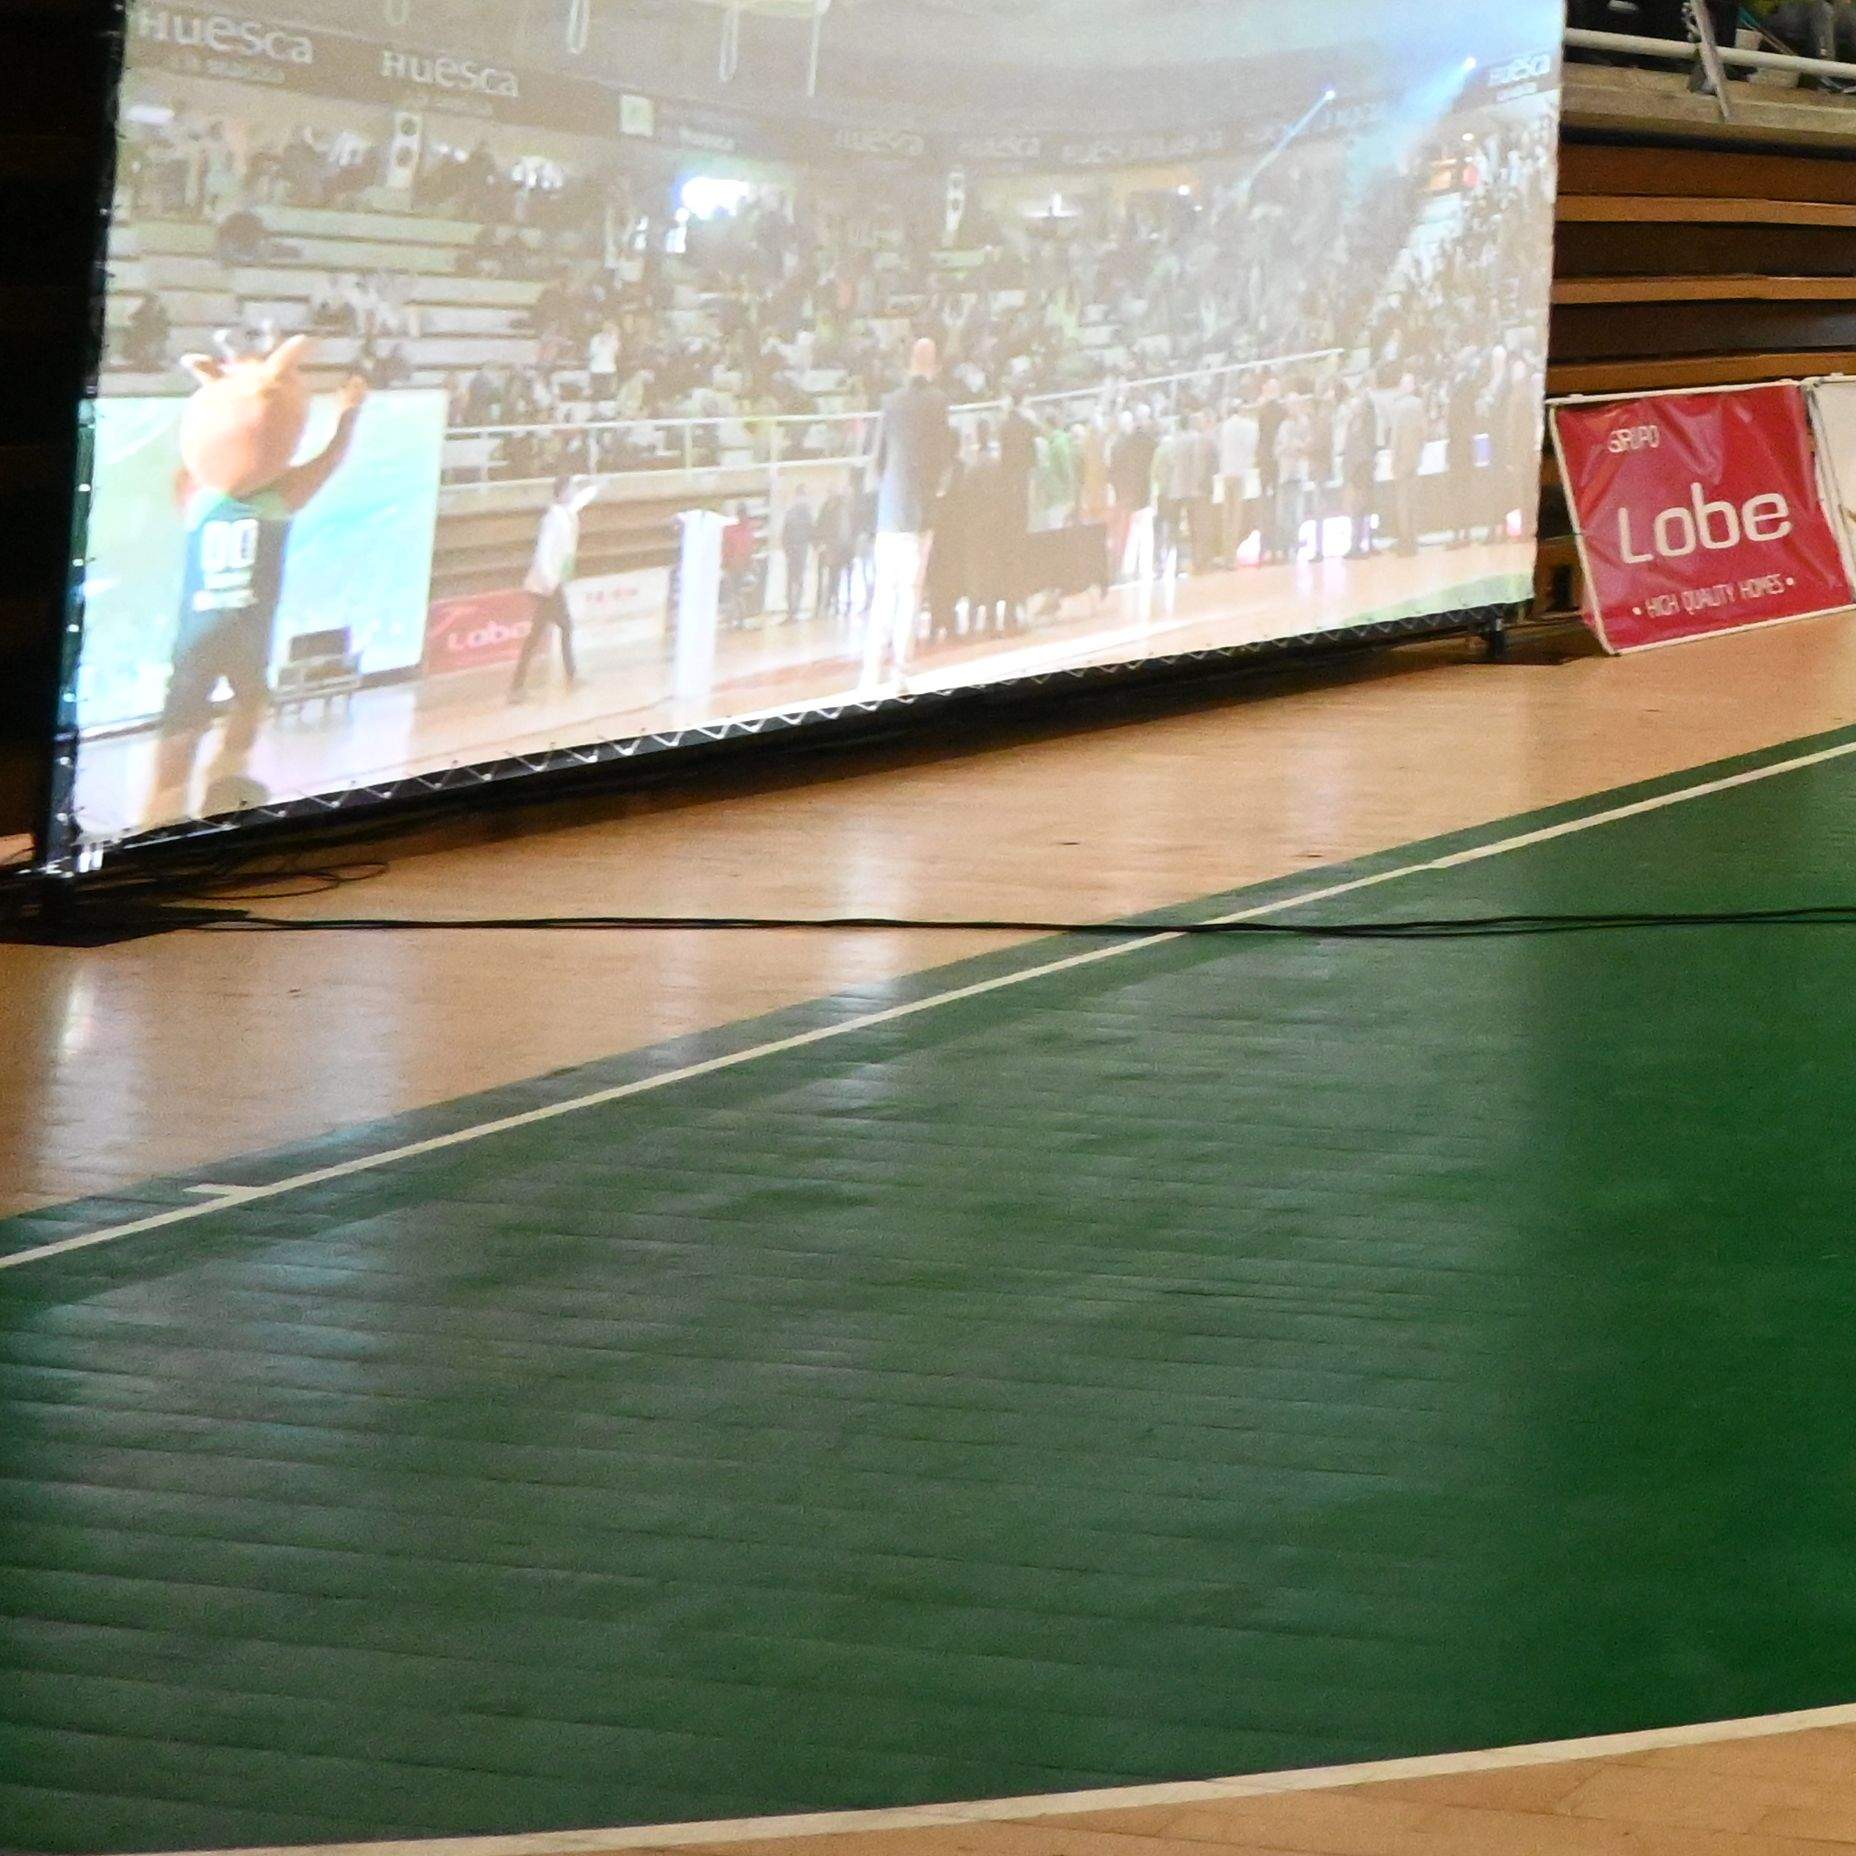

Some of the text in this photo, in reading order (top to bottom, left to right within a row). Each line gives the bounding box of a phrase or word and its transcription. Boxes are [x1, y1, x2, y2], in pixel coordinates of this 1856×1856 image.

[1608, 425, 1659, 453] GRUPO
[1618, 482, 1792, 564] Lobe
[1645, 574, 1782, 617] HIGH QUALITY HOMES
